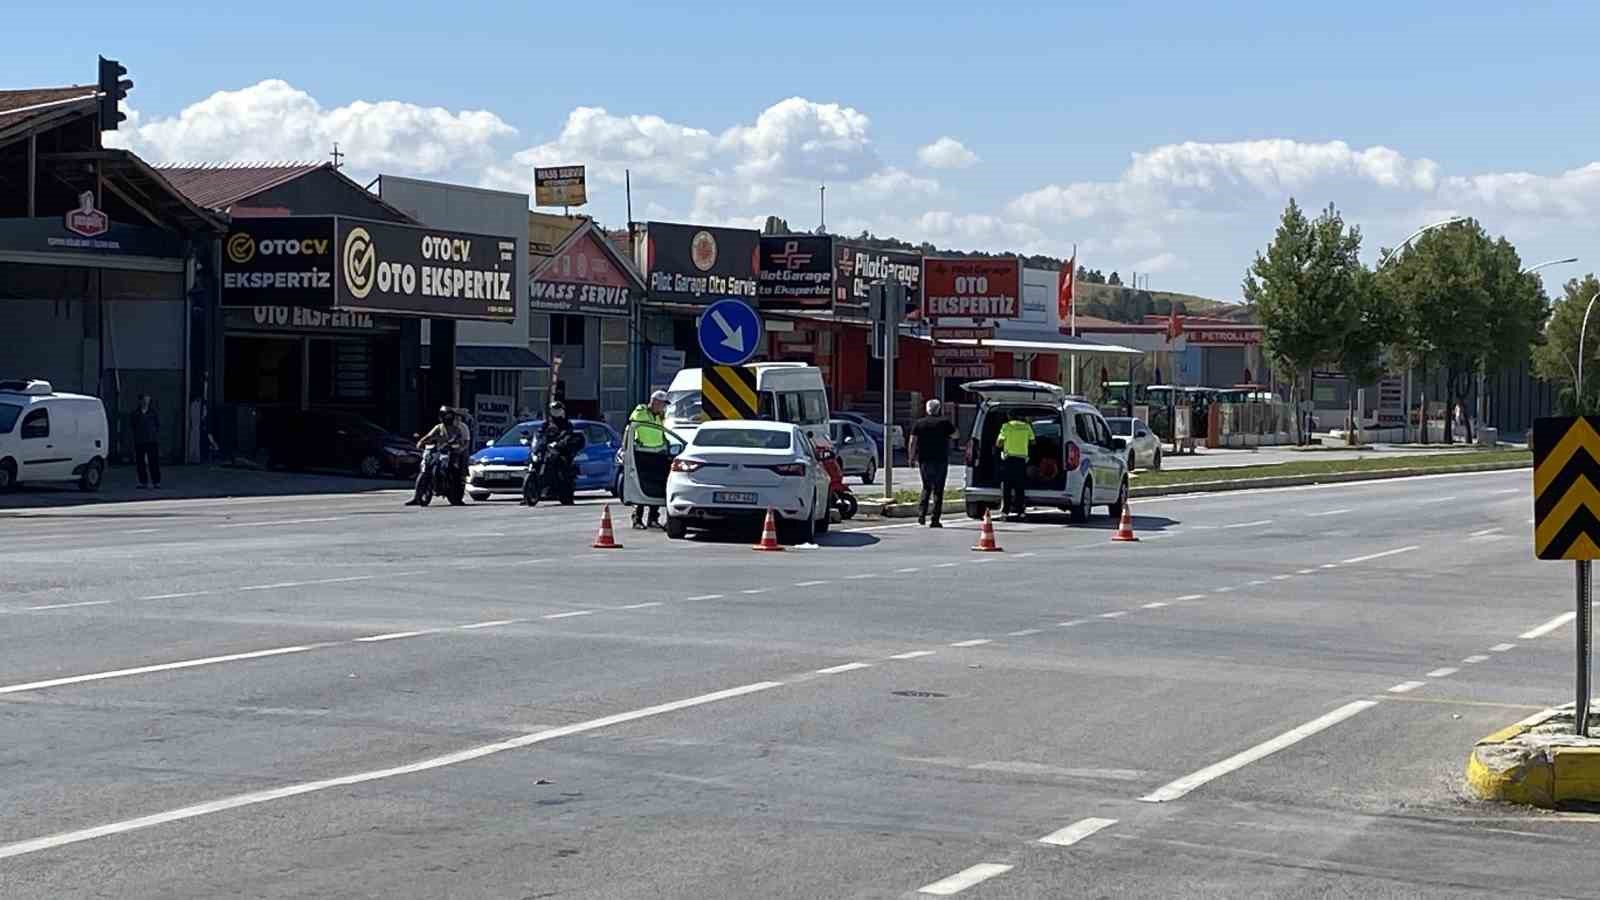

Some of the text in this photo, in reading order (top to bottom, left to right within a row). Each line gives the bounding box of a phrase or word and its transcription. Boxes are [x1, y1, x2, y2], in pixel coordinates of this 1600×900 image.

[259, 238, 329, 256] OTOCV
[421, 235, 471, 262] OTOCV
[223, 266, 331, 289] EKSPERTİZ
[377, 261, 511, 301] OTO EKSPERTİZ
[651, 271, 757, 296] Pilot Garage Oto Servis
[955, 276, 988, 295] OTO
[530, 281, 576, 299] WASS
[928, 293, 1014, 314] EKSPERTİZ
